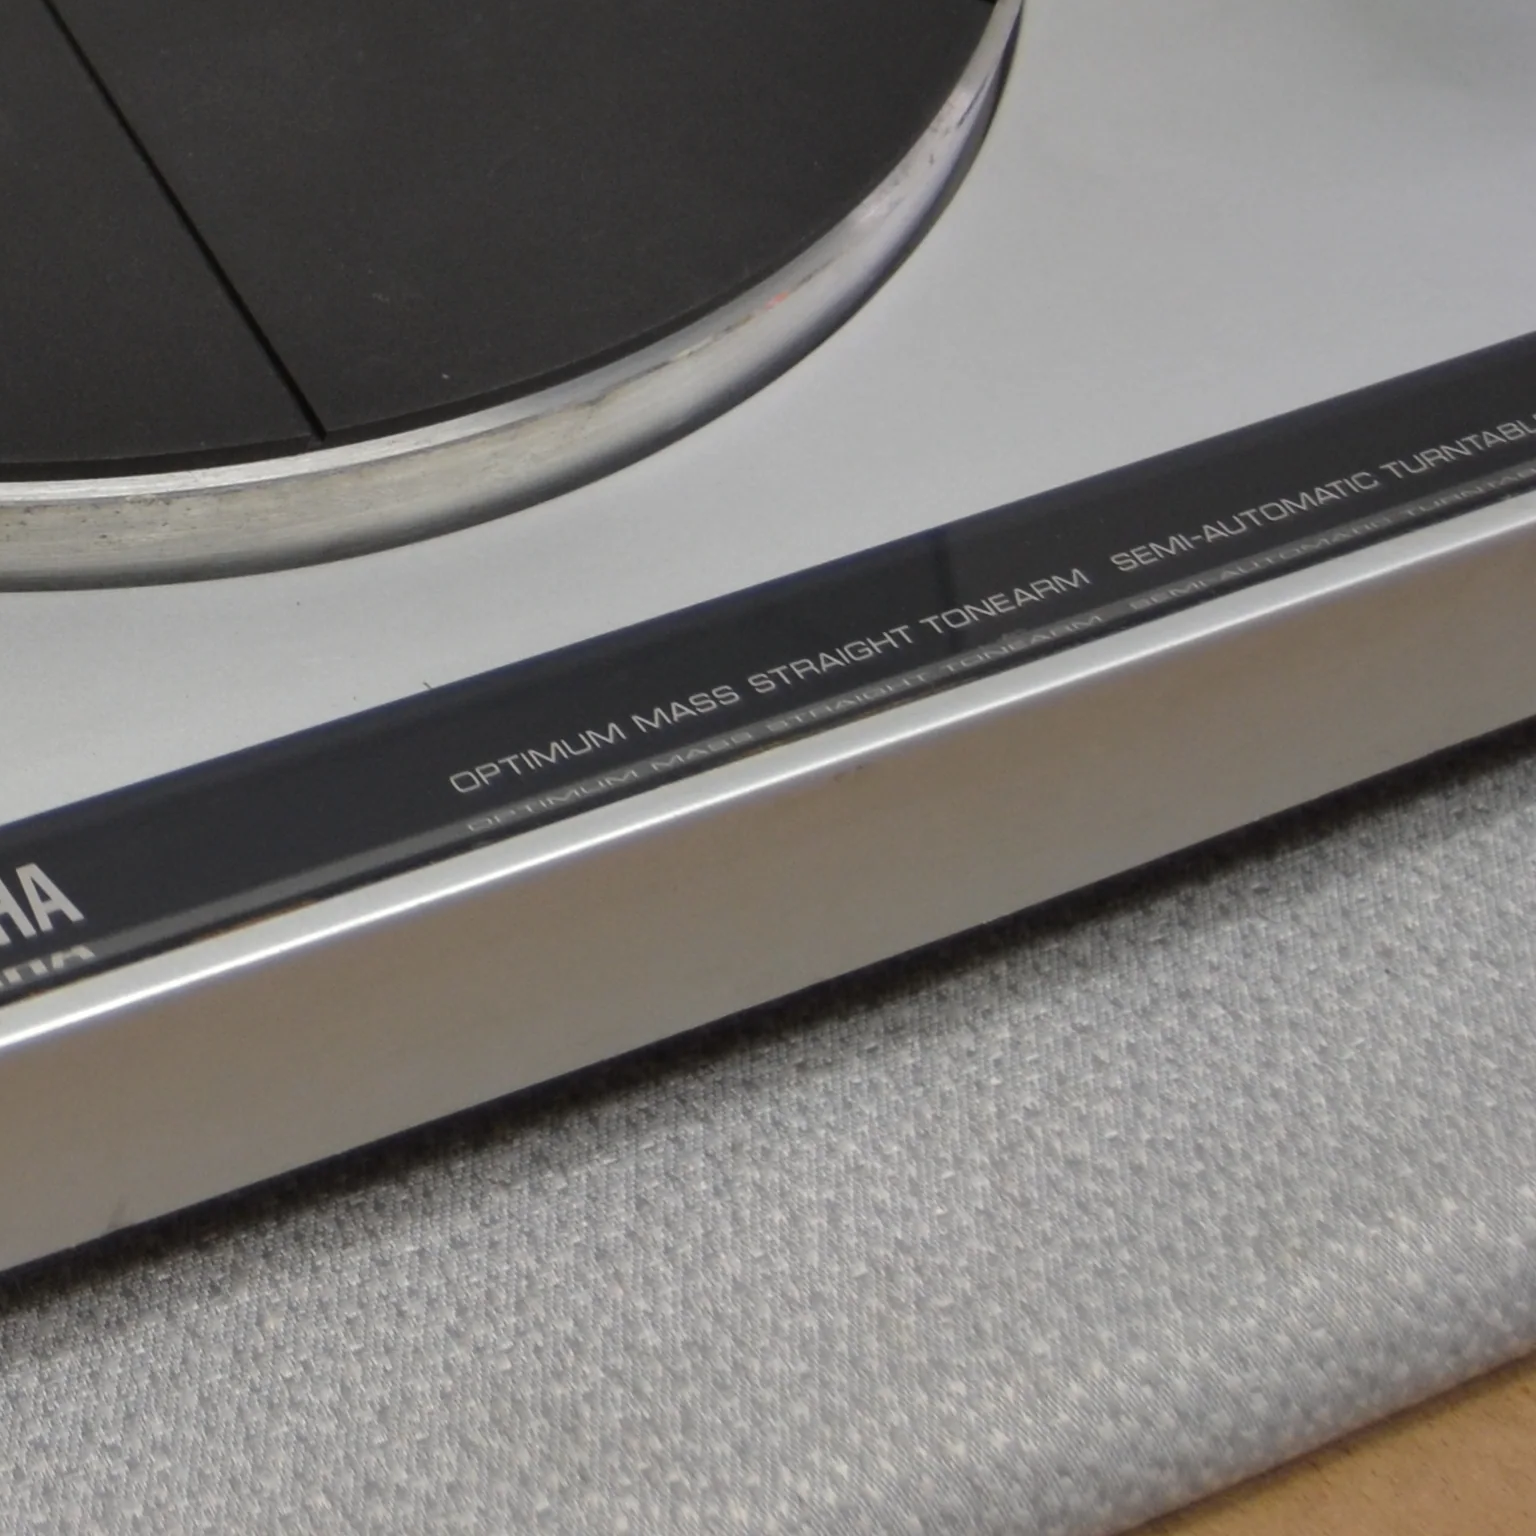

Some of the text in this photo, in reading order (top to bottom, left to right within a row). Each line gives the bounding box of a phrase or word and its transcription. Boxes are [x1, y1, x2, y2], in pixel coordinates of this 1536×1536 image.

[449, 722, 627, 794] OPTIMUM
[631, 684, 740, 733] MASS
[747, 624, 919, 694] STRAIGHT
[919, 567, 1092, 636] TONEARM
[1109, 471, 1380, 572] SEMI-AUTOMATIC
[1379, 413, 1536, 479] TURNTABL
